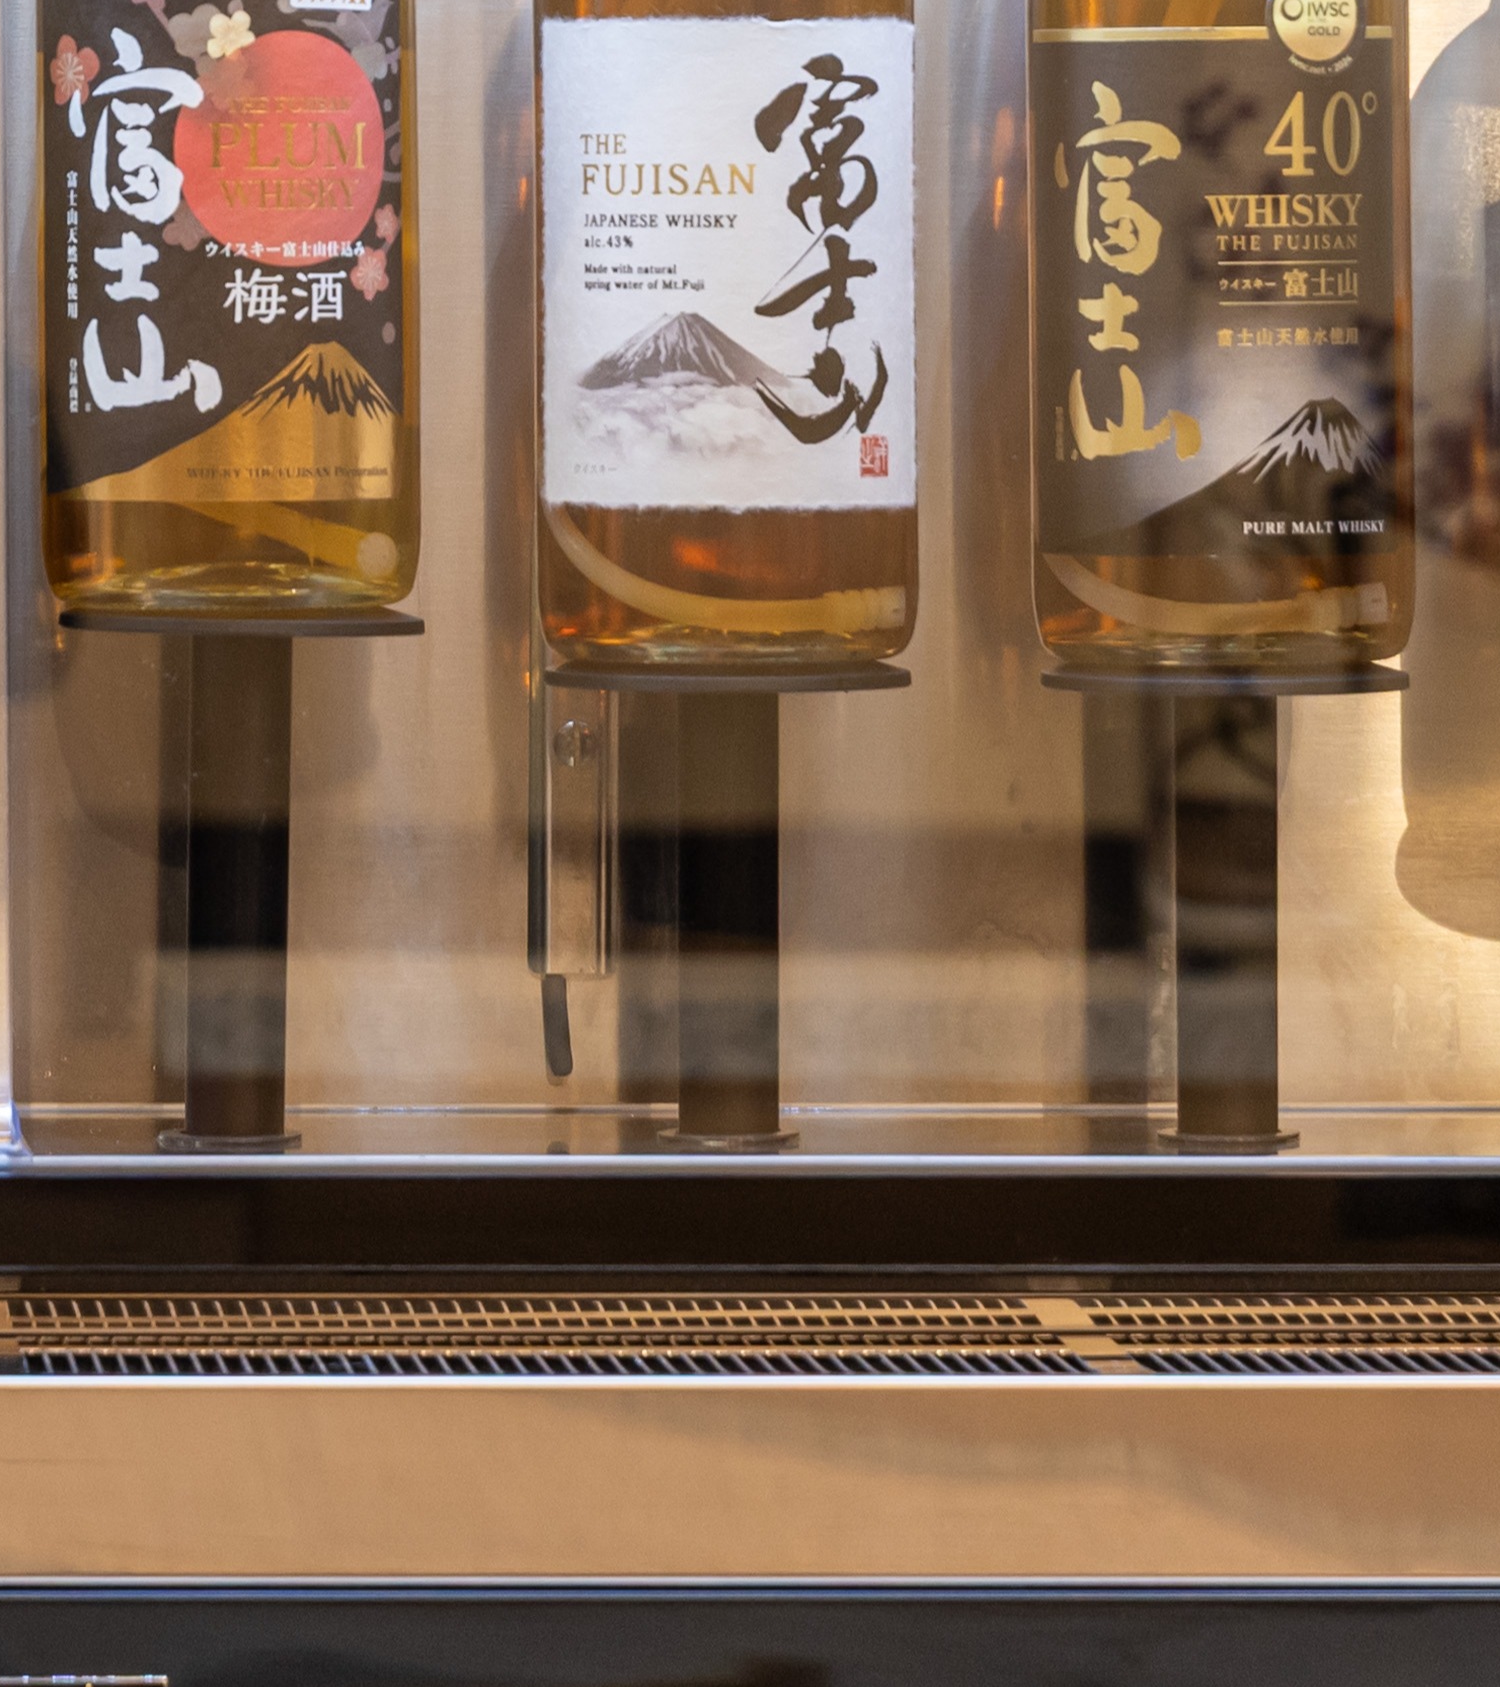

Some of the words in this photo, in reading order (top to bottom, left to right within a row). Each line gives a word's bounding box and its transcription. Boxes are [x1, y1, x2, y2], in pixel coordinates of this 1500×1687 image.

[1307, 1, 1350, 17] IWSC
[1307, 26, 1341, 37] GOLD
[209, 122, 367, 171] PLUM
[580, 133, 627, 155] THE
[581, 163, 757, 196] FUJISAN
[219, 179, 360, 211] WHISKY
[68, 27, 222, 413] 富士山
[584, 214, 659, 228] JAPANESE
[665, 214, 738, 228] WHISKY
[1205, 193, 1363, 229] WHISKY
[754, 53, 889, 445] 富士山
[1217, 235, 1261, 251] THE
[1273, 234, 1359, 251] FUJISAN
[584, 264, 608, 274] Made
[611, 263, 633, 274] with
[637, 264, 677, 274] natural
[1054, 80, 1201, 461] 富士山
[223, 268, 348, 324] 梅酒
[584, 280, 611, 292] spring
[614, 281, 644, 290] water
[647, 279, 659, 290] of
[1218, 277, 1278, 291] ウイスキー
[1283, 268, 1359, 299] 富士山
[1217, 327, 1359, 347] 富士山天然水使用
[1243, 521, 1286, 535] PURE
[1291, 520, 1333, 534] MALT
[1338, 519, 1385, 534] WHISKY
